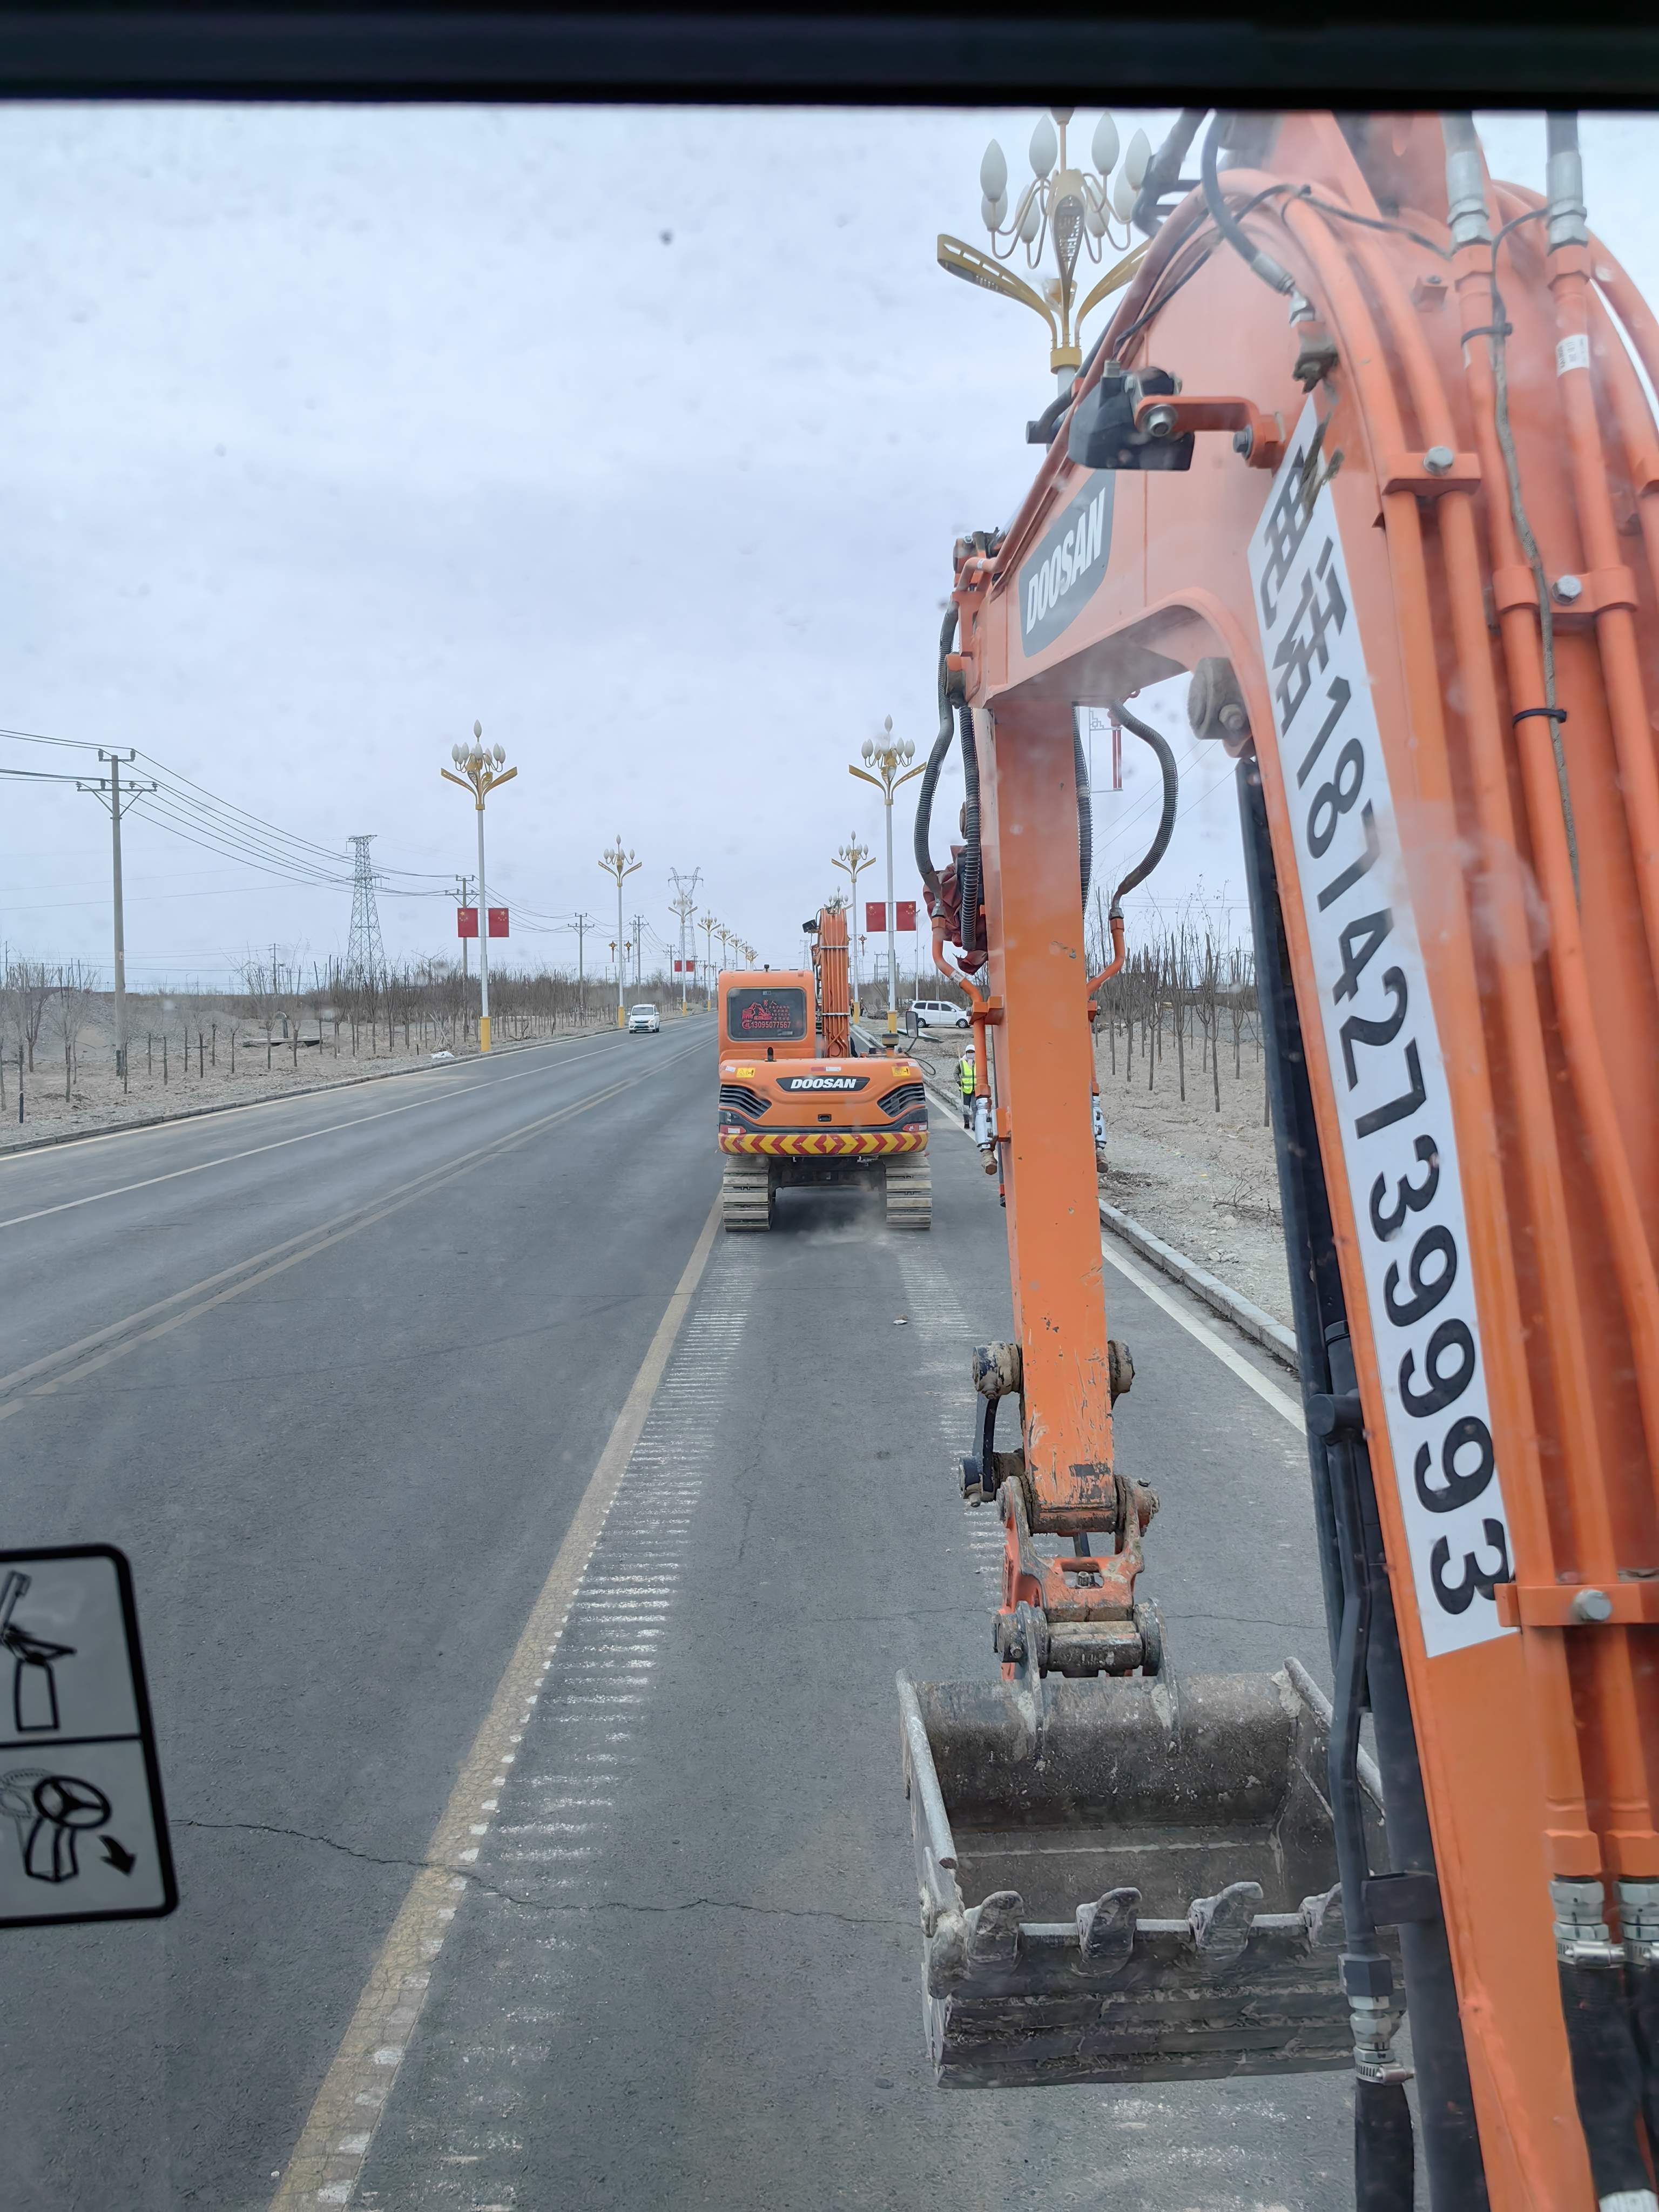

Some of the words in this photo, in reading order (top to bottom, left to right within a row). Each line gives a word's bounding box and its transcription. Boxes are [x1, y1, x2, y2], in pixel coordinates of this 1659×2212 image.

[1026, 487, 1105, 635] DOOSAN
[791, 1078, 857, 1089] DOOSAN
[1260, 444, 1510, 1615] 电话18742739993
